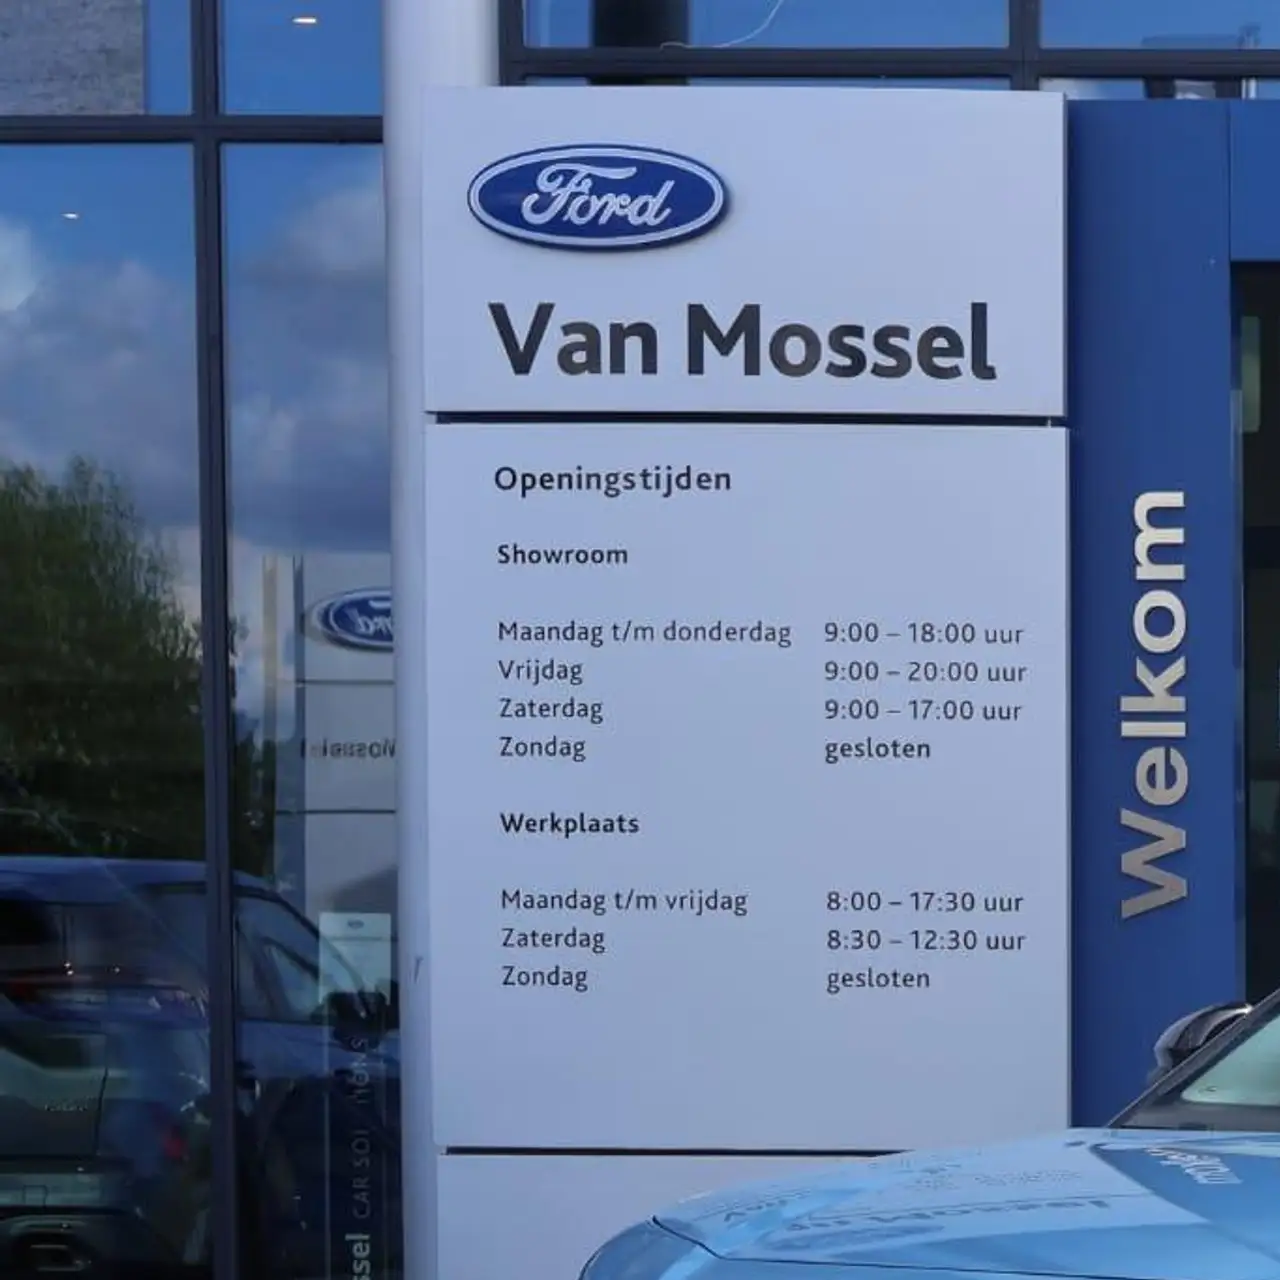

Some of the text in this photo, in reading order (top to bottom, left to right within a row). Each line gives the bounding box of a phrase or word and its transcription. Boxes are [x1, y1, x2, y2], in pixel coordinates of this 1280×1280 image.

[521, 162, 675, 228] Ford
[487, 301, 997, 380] Van Mossel
[494, 464, 732, 499] Openingstijden
[497, 543, 629, 565] Showroom
[498, 619, 605, 647] Maandag
[611, 620, 655, 643] t/m
[663, 619, 792, 646] donderdag
[824, 622, 879, 644] 9:00
[908, 622, 976, 644] 18:00
[984, 628, 1024, 645] uur
[498, 658, 583, 686] Vrijdag
[824, 660, 879, 682] 9:00
[908, 660, 979, 682] 20:00
[987, 666, 1027, 682] uur
[499, 696, 604, 725] Zaterdag
[824, 698, 879, 720] 9:00
[908, 698, 974, 721] 17:00
[982, 704, 1022, 721] uur
[1120, 489, 1188, 919] Welkom
[499, 735, 931, 764] Zondag gesloten
[500, 811, 640, 840] Werkplaats
[501, 888, 606, 917] Maandag
[614, 888, 657, 912] t/m
[665, 888, 748, 916] vrijdag
[826, 891, 882, 912] 8:00
[909, 891, 975, 913] 17:30
[984, 896, 1024, 913] uur
[501, 926, 606, 955] Zaterdag
[827, 929, 882, 950] 8:30
[910, 929, 978, 950] 12:30
[986, 934, 1025, 950] uur
[502, 964, 930, 994] Zondag gesloten
